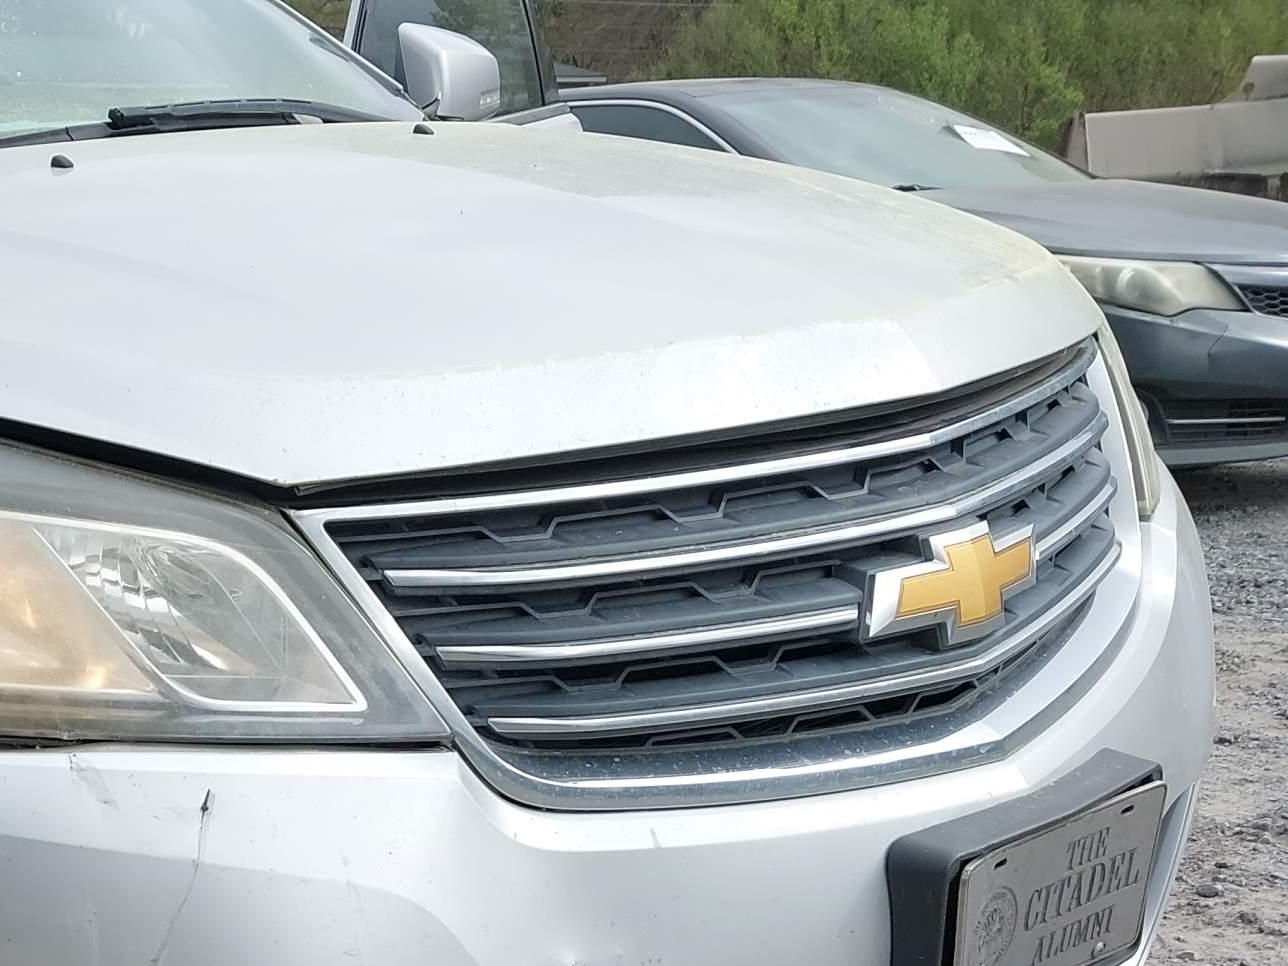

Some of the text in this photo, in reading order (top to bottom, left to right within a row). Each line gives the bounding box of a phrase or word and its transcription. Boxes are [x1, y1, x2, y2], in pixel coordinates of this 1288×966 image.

[1066, 826, 1111, 871] THE
[1023, 845, 1140, 932] CITADEL
[1030, 903, 1116, 966] ALUMNI
